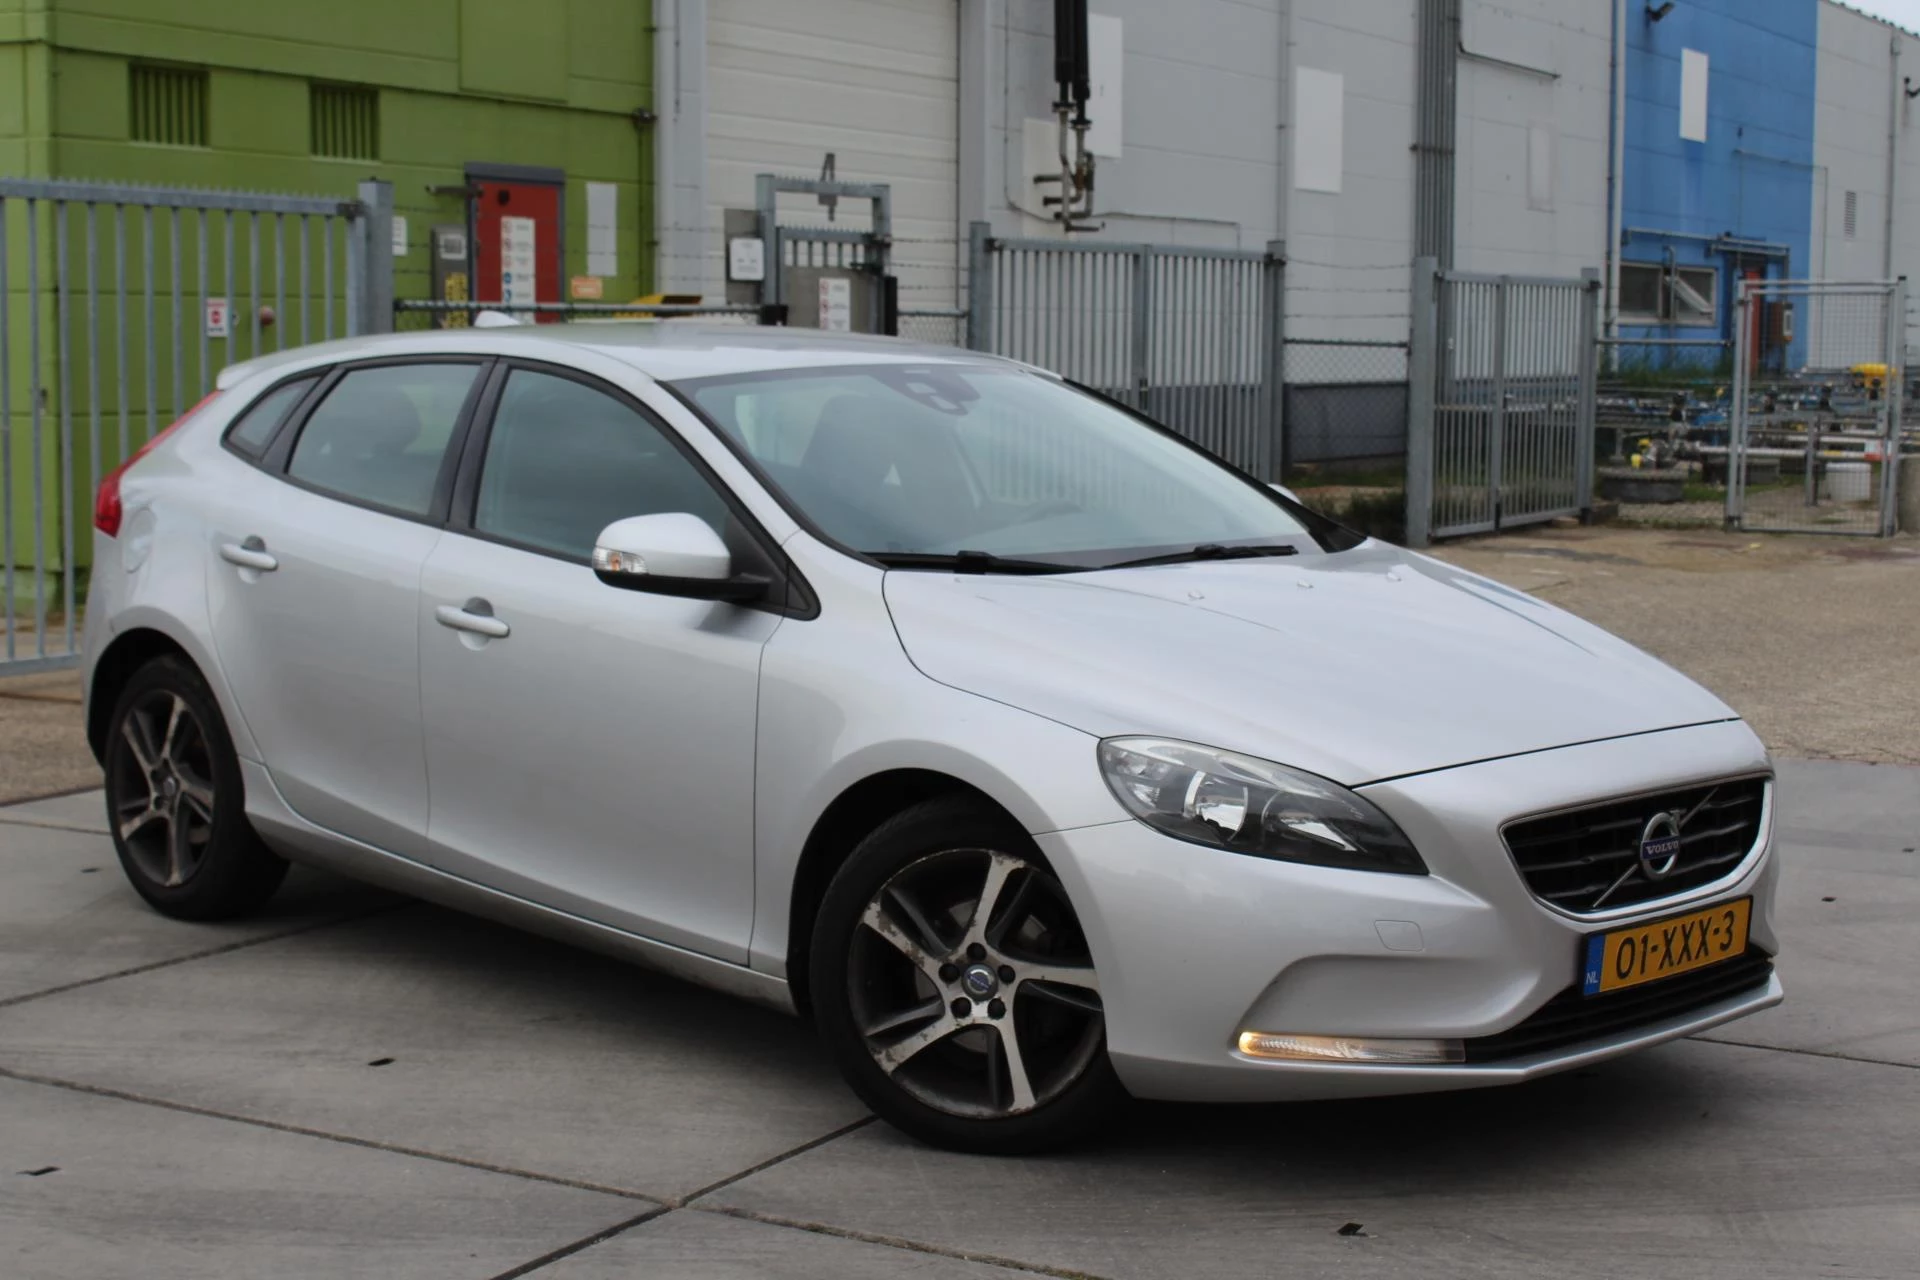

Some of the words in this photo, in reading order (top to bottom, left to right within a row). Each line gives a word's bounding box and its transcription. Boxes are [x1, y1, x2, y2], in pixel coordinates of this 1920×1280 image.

[1645, 840, 1679, 855] VOLVO
[1616, 910, 1735, 980] 01-XXX-3
[1585, 971, 1598, 985] NL
